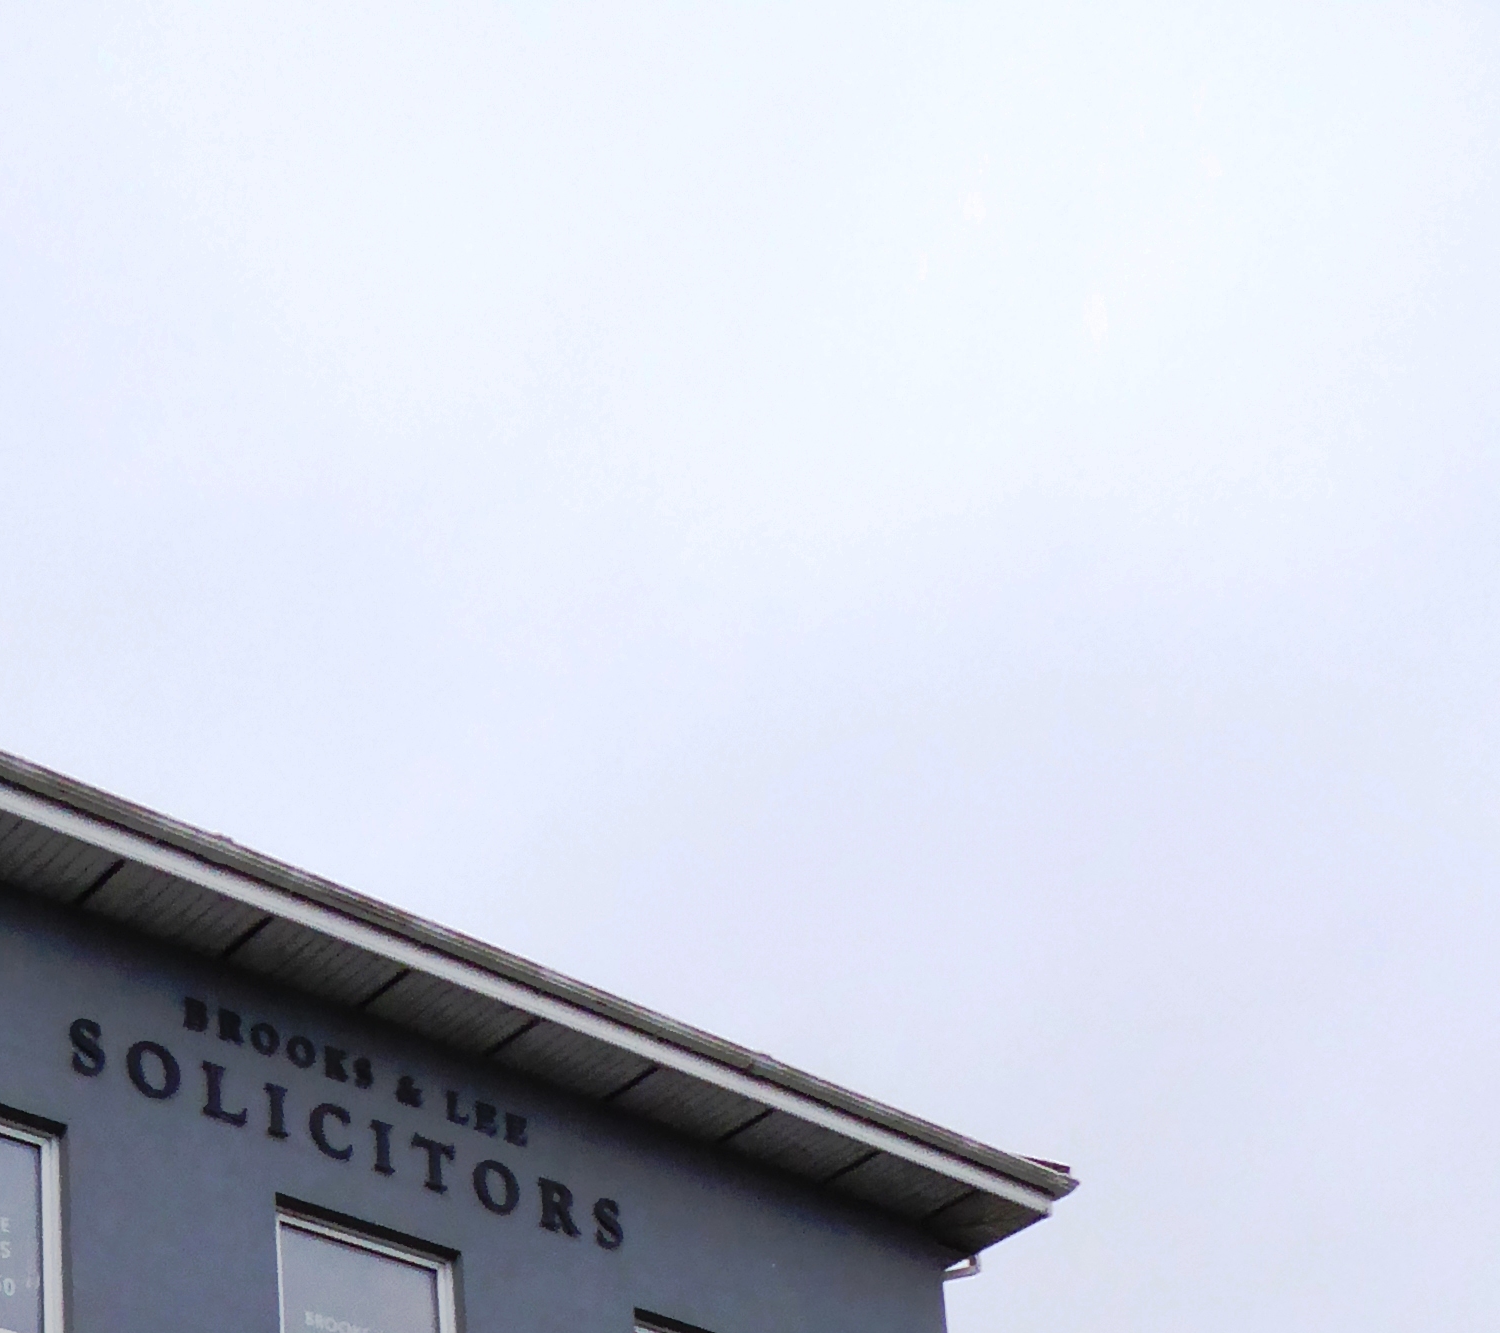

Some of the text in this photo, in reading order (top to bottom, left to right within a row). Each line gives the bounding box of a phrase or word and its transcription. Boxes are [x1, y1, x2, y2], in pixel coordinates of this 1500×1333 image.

[69, 1018, 624, 1250] SOLICITORS
[184, 997, 529, 1147] BROOKS & LEE
